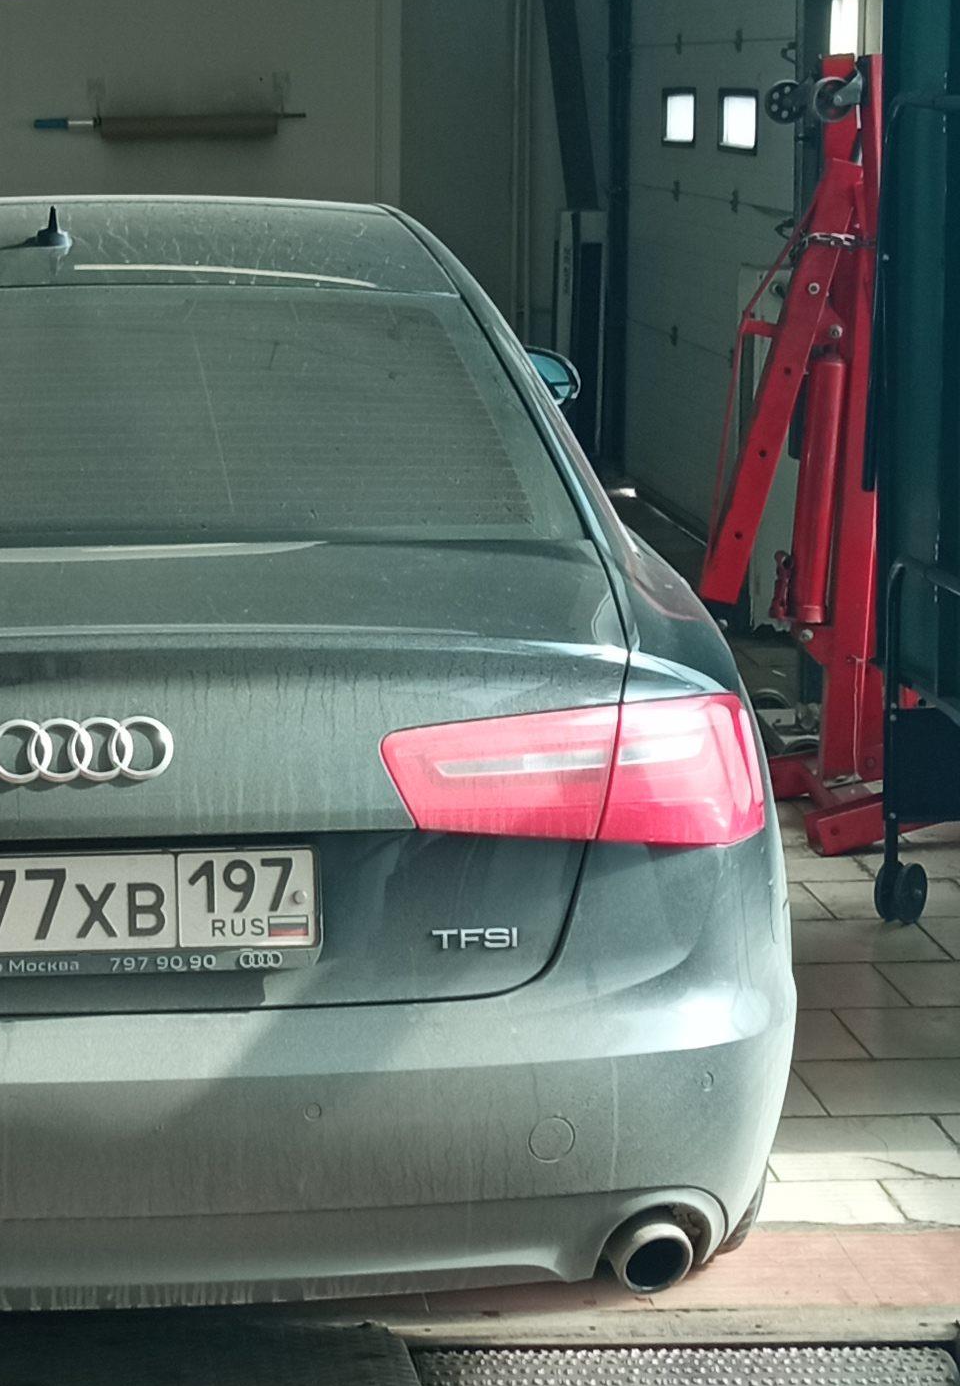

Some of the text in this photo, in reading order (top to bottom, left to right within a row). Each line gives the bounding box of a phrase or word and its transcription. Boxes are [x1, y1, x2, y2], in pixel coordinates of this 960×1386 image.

[188, 857, 294, 914] 197
[211, 918, 265, 938] RUS
[431, 926, 518, 949] TFSI
[9, 959, 81, 973] Москва
[110, 957, 148, 972] 797
[156, 955, 184, 970] 90
[189, 954, 218, 969] 90
